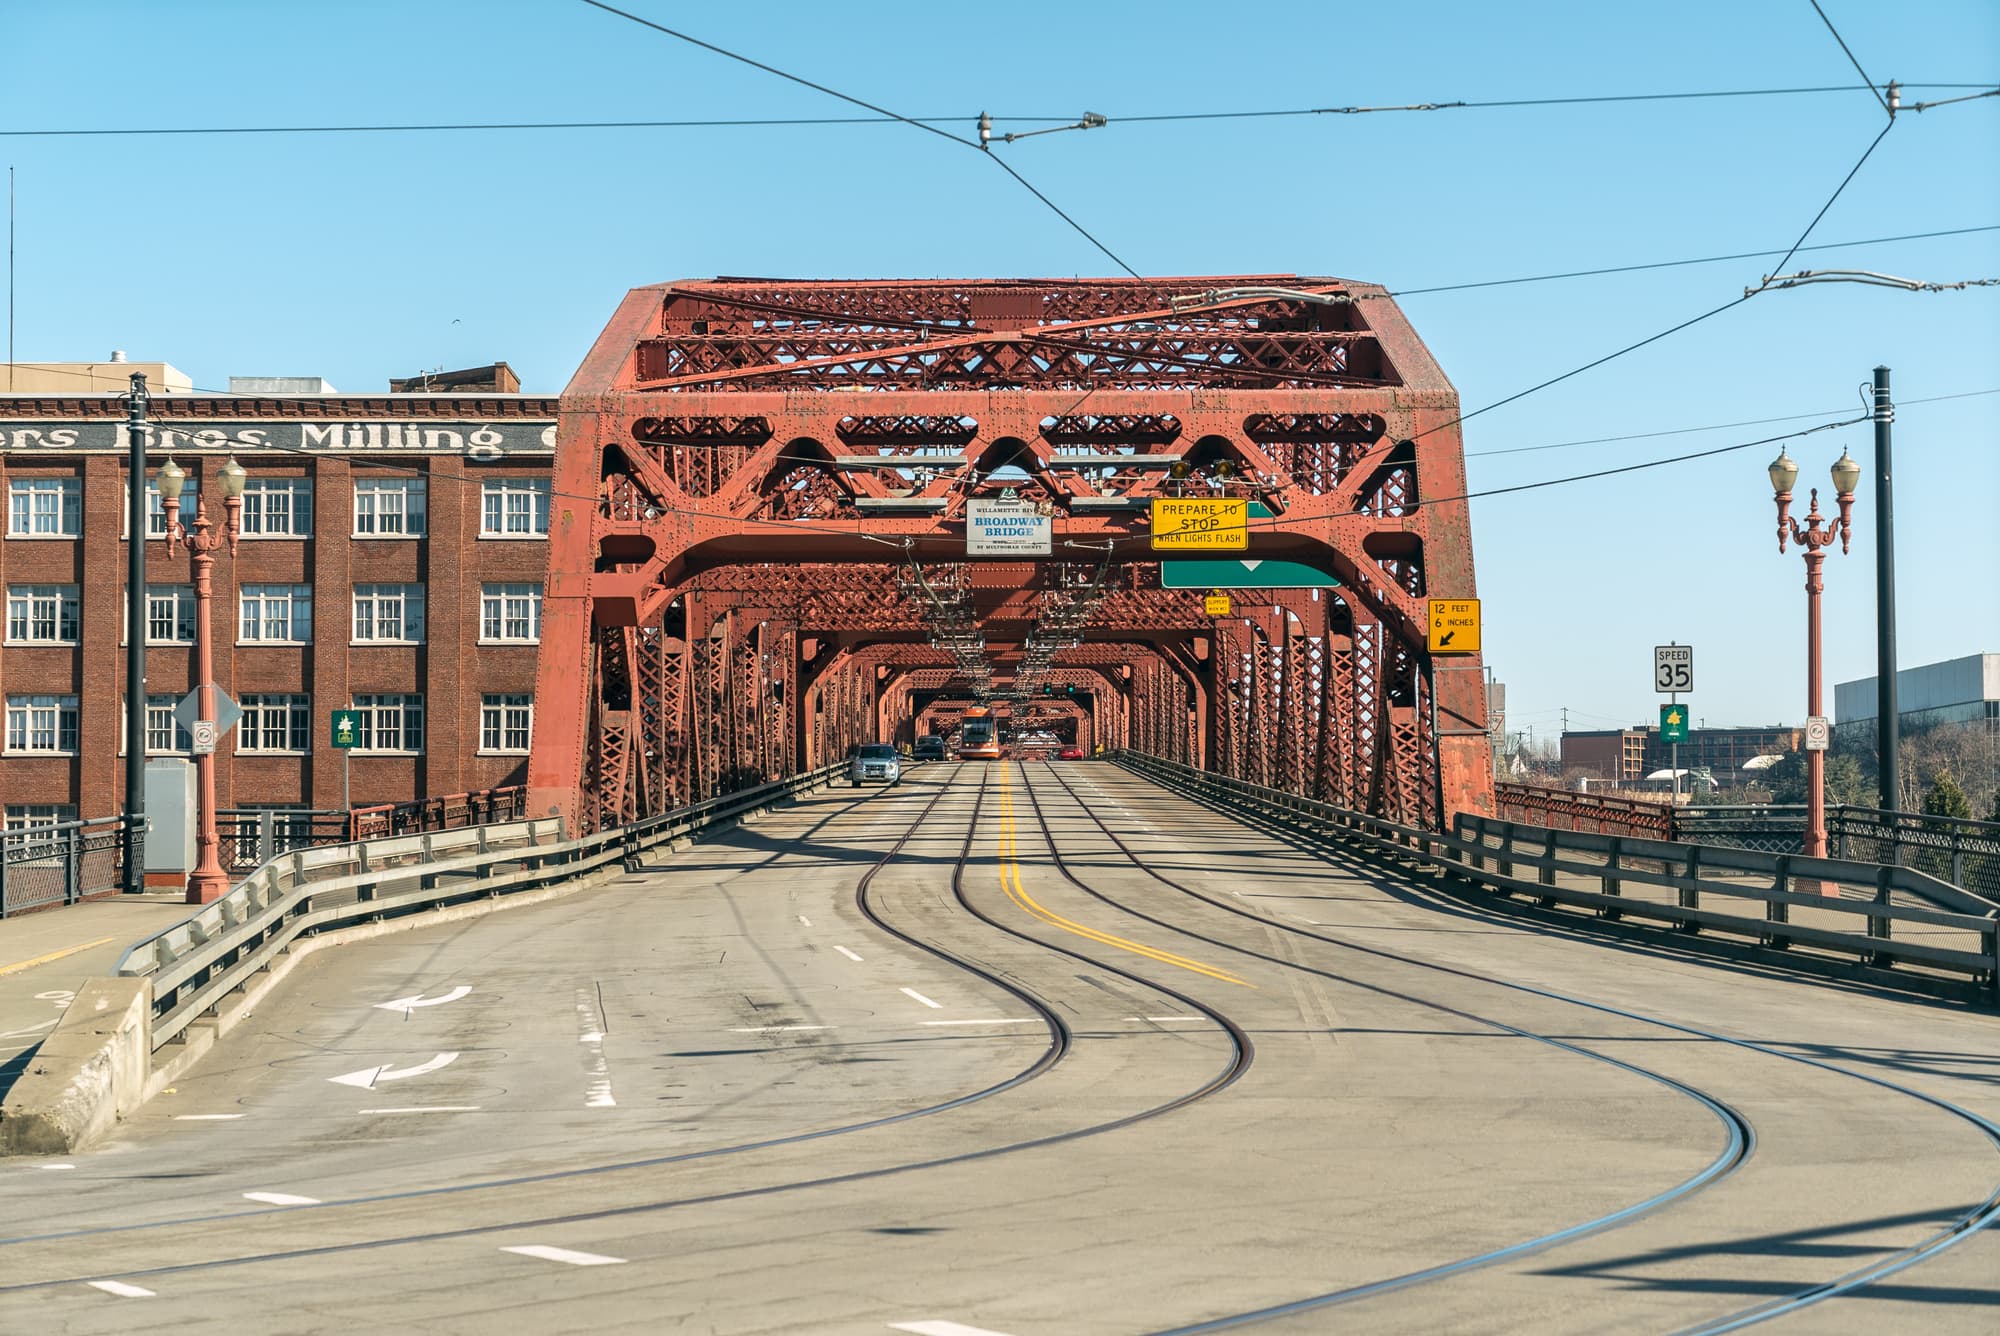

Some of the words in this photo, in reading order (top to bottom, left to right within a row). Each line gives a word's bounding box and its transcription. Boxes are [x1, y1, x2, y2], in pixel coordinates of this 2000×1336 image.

[0, 429, 79, 448] rs
[113, 424, 272, 448] Bros.
[300, 423, 504, 462] Milling
[1162, 505, 1216, 515] PREPARE
[1223, 505, 1237, 515] TO
[975, 517, 1044, 526] BROADWAY
[1181, 519, 1219, 530] STOP
[985, 528, 1034, 536] BRIDGE
[1158, 534, 1181, 543] WHEN
[1184, 534, 1212, 543] LIGHTS
[1215, 534, 1241, 543] FLASH
[1435, 603, 1445, 614] 12
[1435, 618, 1442, 628] 6
[1447, 618, 1474, 626] INCHES
[1659, 651, 1689, 661] SPEED
[1659, 663, 1690, 687] 35
